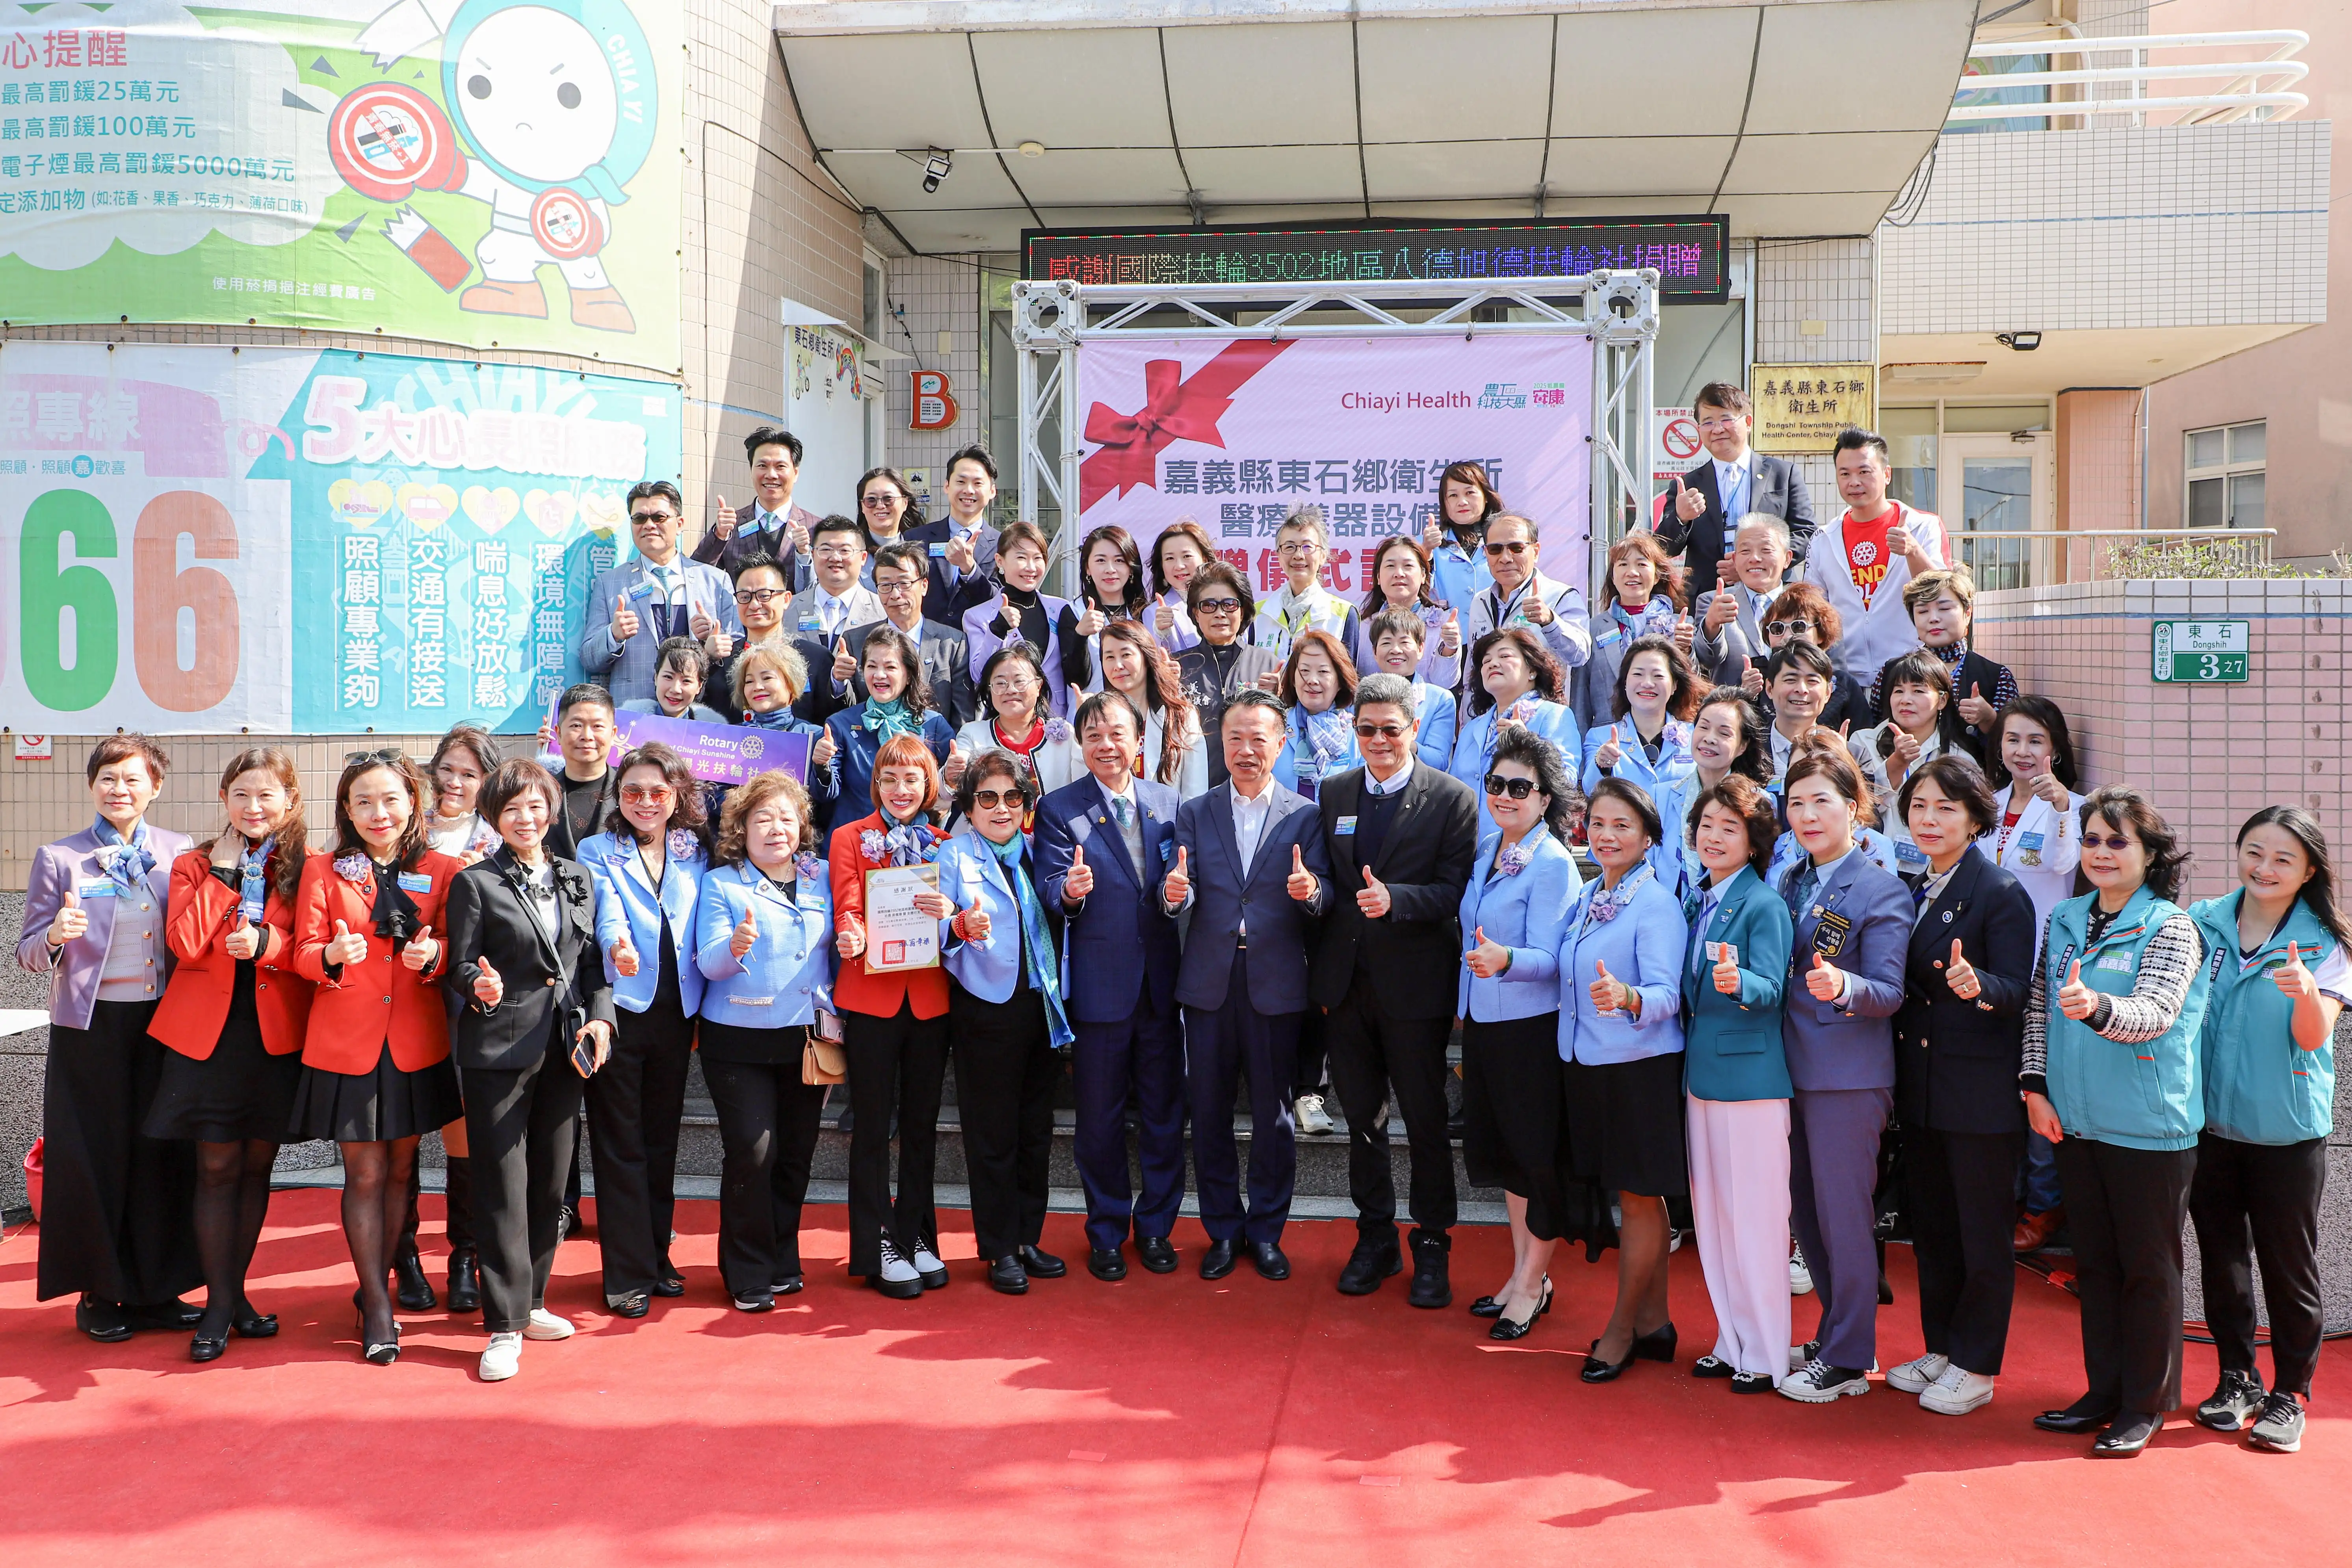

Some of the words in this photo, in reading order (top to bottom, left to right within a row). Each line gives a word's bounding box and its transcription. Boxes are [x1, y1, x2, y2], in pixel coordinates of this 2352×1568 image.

[2, 30, 127, 69] 心提醒
[607, 33, 641, 94] CHIA
[1, 80, 179, 105] 最高罰鍰25萬元
[2, 115, 196, 140] 最高罰鍰100萬元
[1, 152, 295, 182] 電子煙最高罰鍰5000萬元
[0, 188, 85, 214] 定添加物
[795, 327, 835, 361] 東石鄉衛生所
[1763, 379, 1865, 396] 嘉義縣東石鄉
[1341, 391, 1400, 414] Chiayi
[1407, 391, 1471, 409] Health
[1788, 399, 1839, 415] 衛生所
[1813, 431, 1836, 439] Chiayi
[1221, 503, 1440, 538] 醫療器設備
[0, 489, 240, 712] 66
[343, 537, 380, 708] 照顧專業夠
[412, 539, 446, 708] 交通有接送
[474, 541, 507, 709] 喘息好放鬆
[535, 543, 565, 705] 環境無障礙
[2188, 624, 2232, 639] 東石
[2158, 638, 2168, 676] 東石鄉東石村
[2193, 641, 2227, 650] Dongshih
[2199, 654, 2243, 679] 3之7
[677, 745, 700, 755] Chiayi
[702, 749, 735, 760] Sunshine
[699, 734, 739, 752] Rotary
